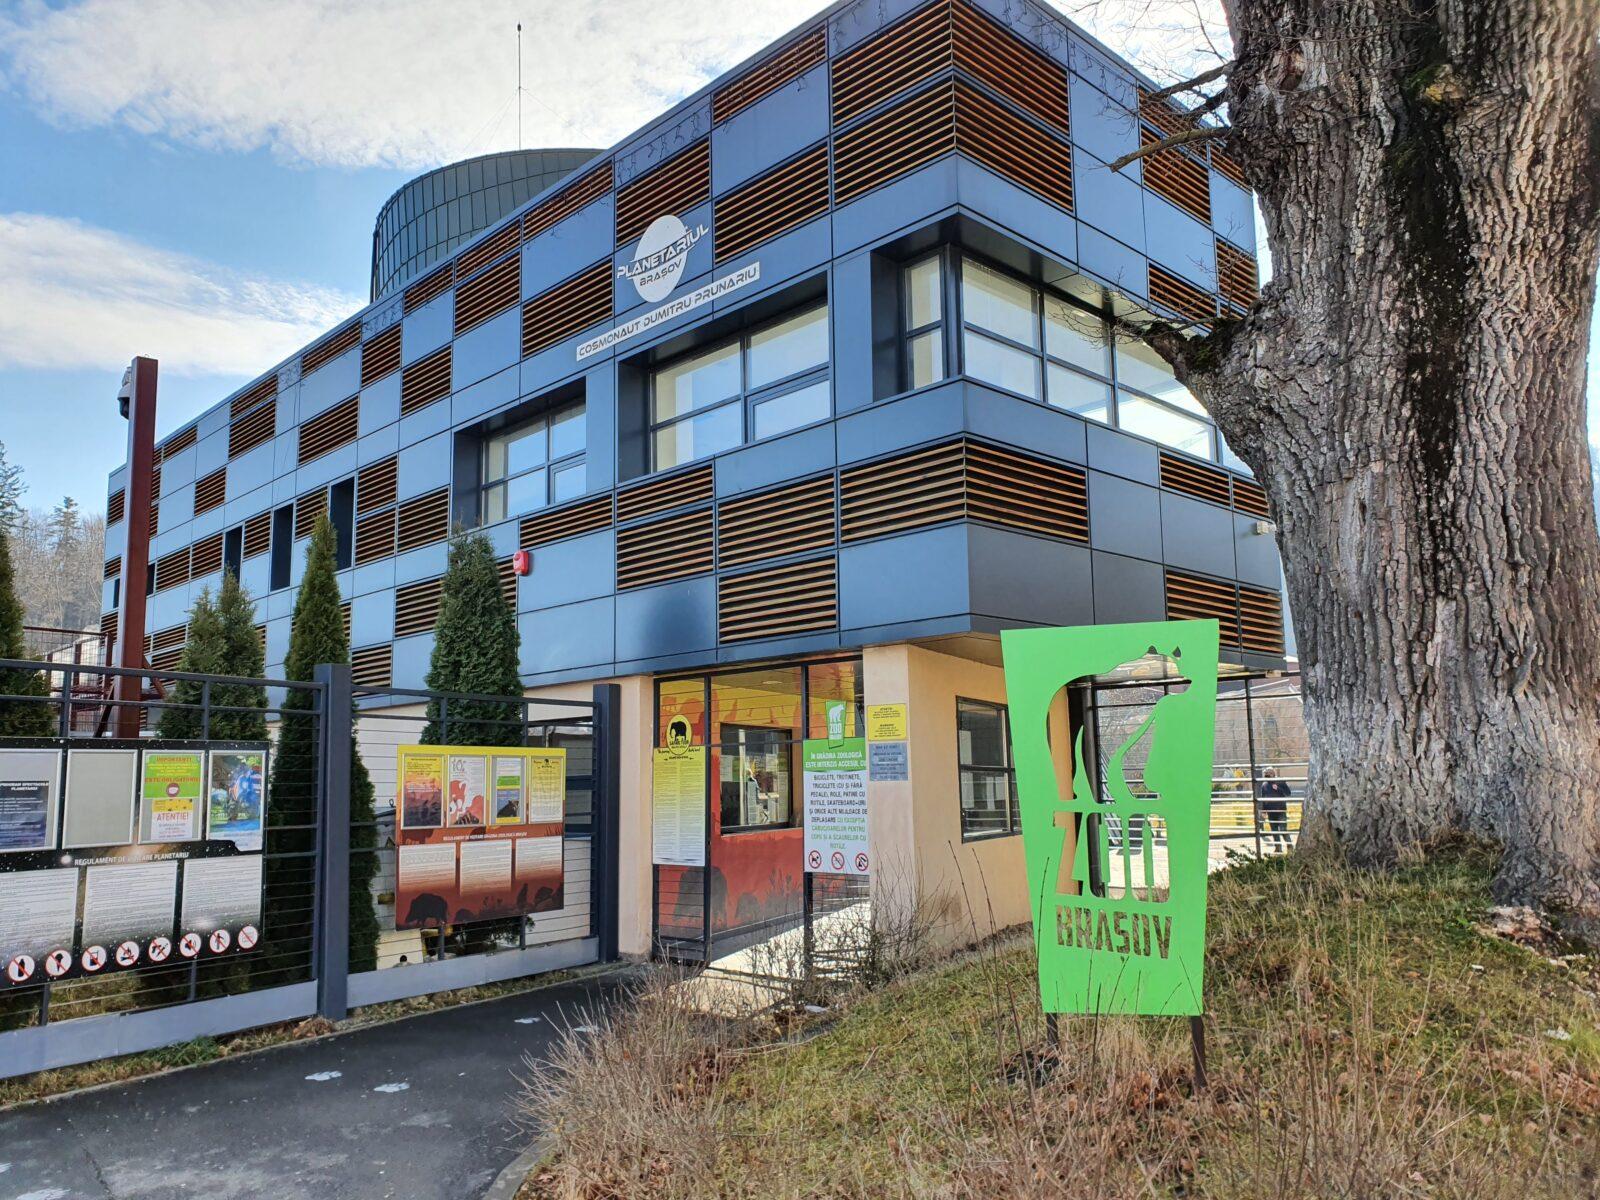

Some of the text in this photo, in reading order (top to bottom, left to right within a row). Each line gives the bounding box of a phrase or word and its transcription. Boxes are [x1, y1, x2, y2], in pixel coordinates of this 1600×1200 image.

[617, 224, 709, 279] PLANETARIUL
[579, 267, 757, 357] COSMONAUT DUMITRU PRUNARIU
[830, 723, 842, 734] ZOO
[74, 856, 118, 866] REGULAMENT
[154, 852, 190, 860] PLANETARIU
[1052, 811, 1170, 903] ZOO
